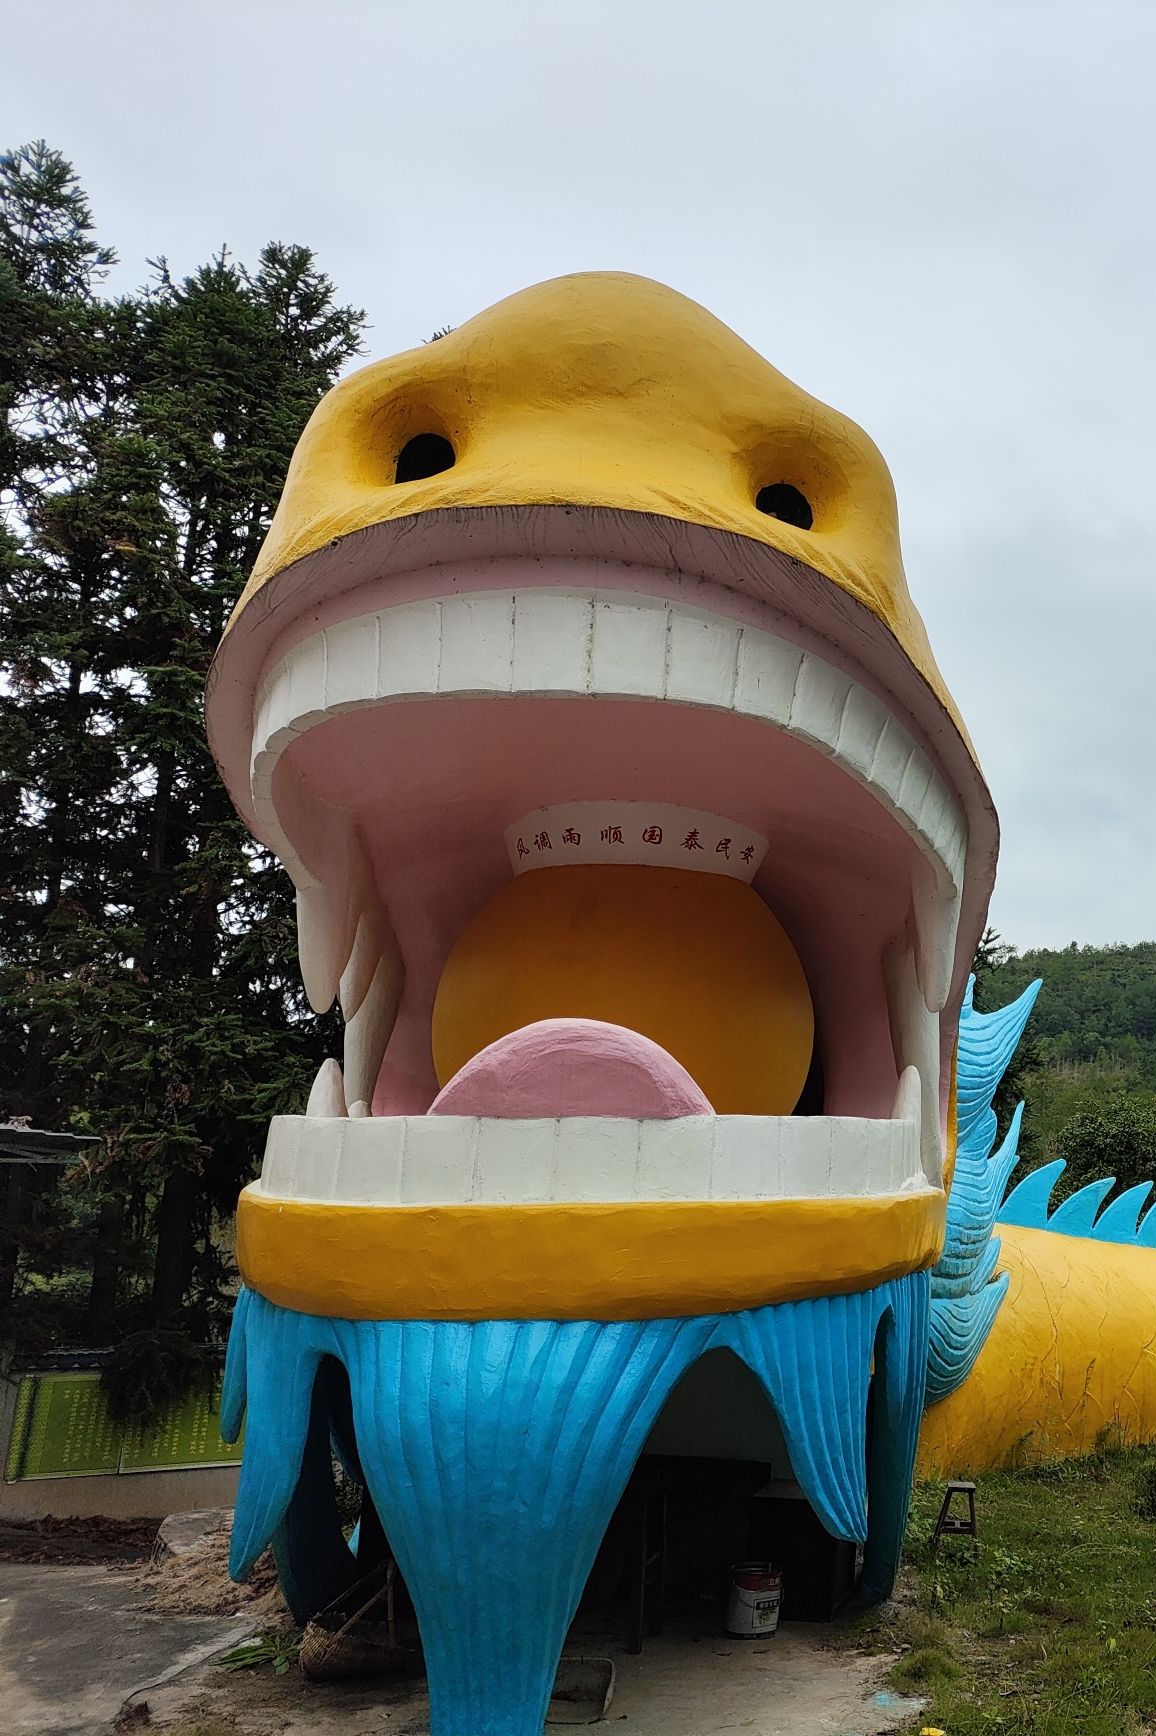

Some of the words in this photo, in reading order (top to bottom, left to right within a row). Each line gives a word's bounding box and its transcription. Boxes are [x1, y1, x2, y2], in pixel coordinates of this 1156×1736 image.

[516, 825, 755, 864] 风调雨顺国泰民安
